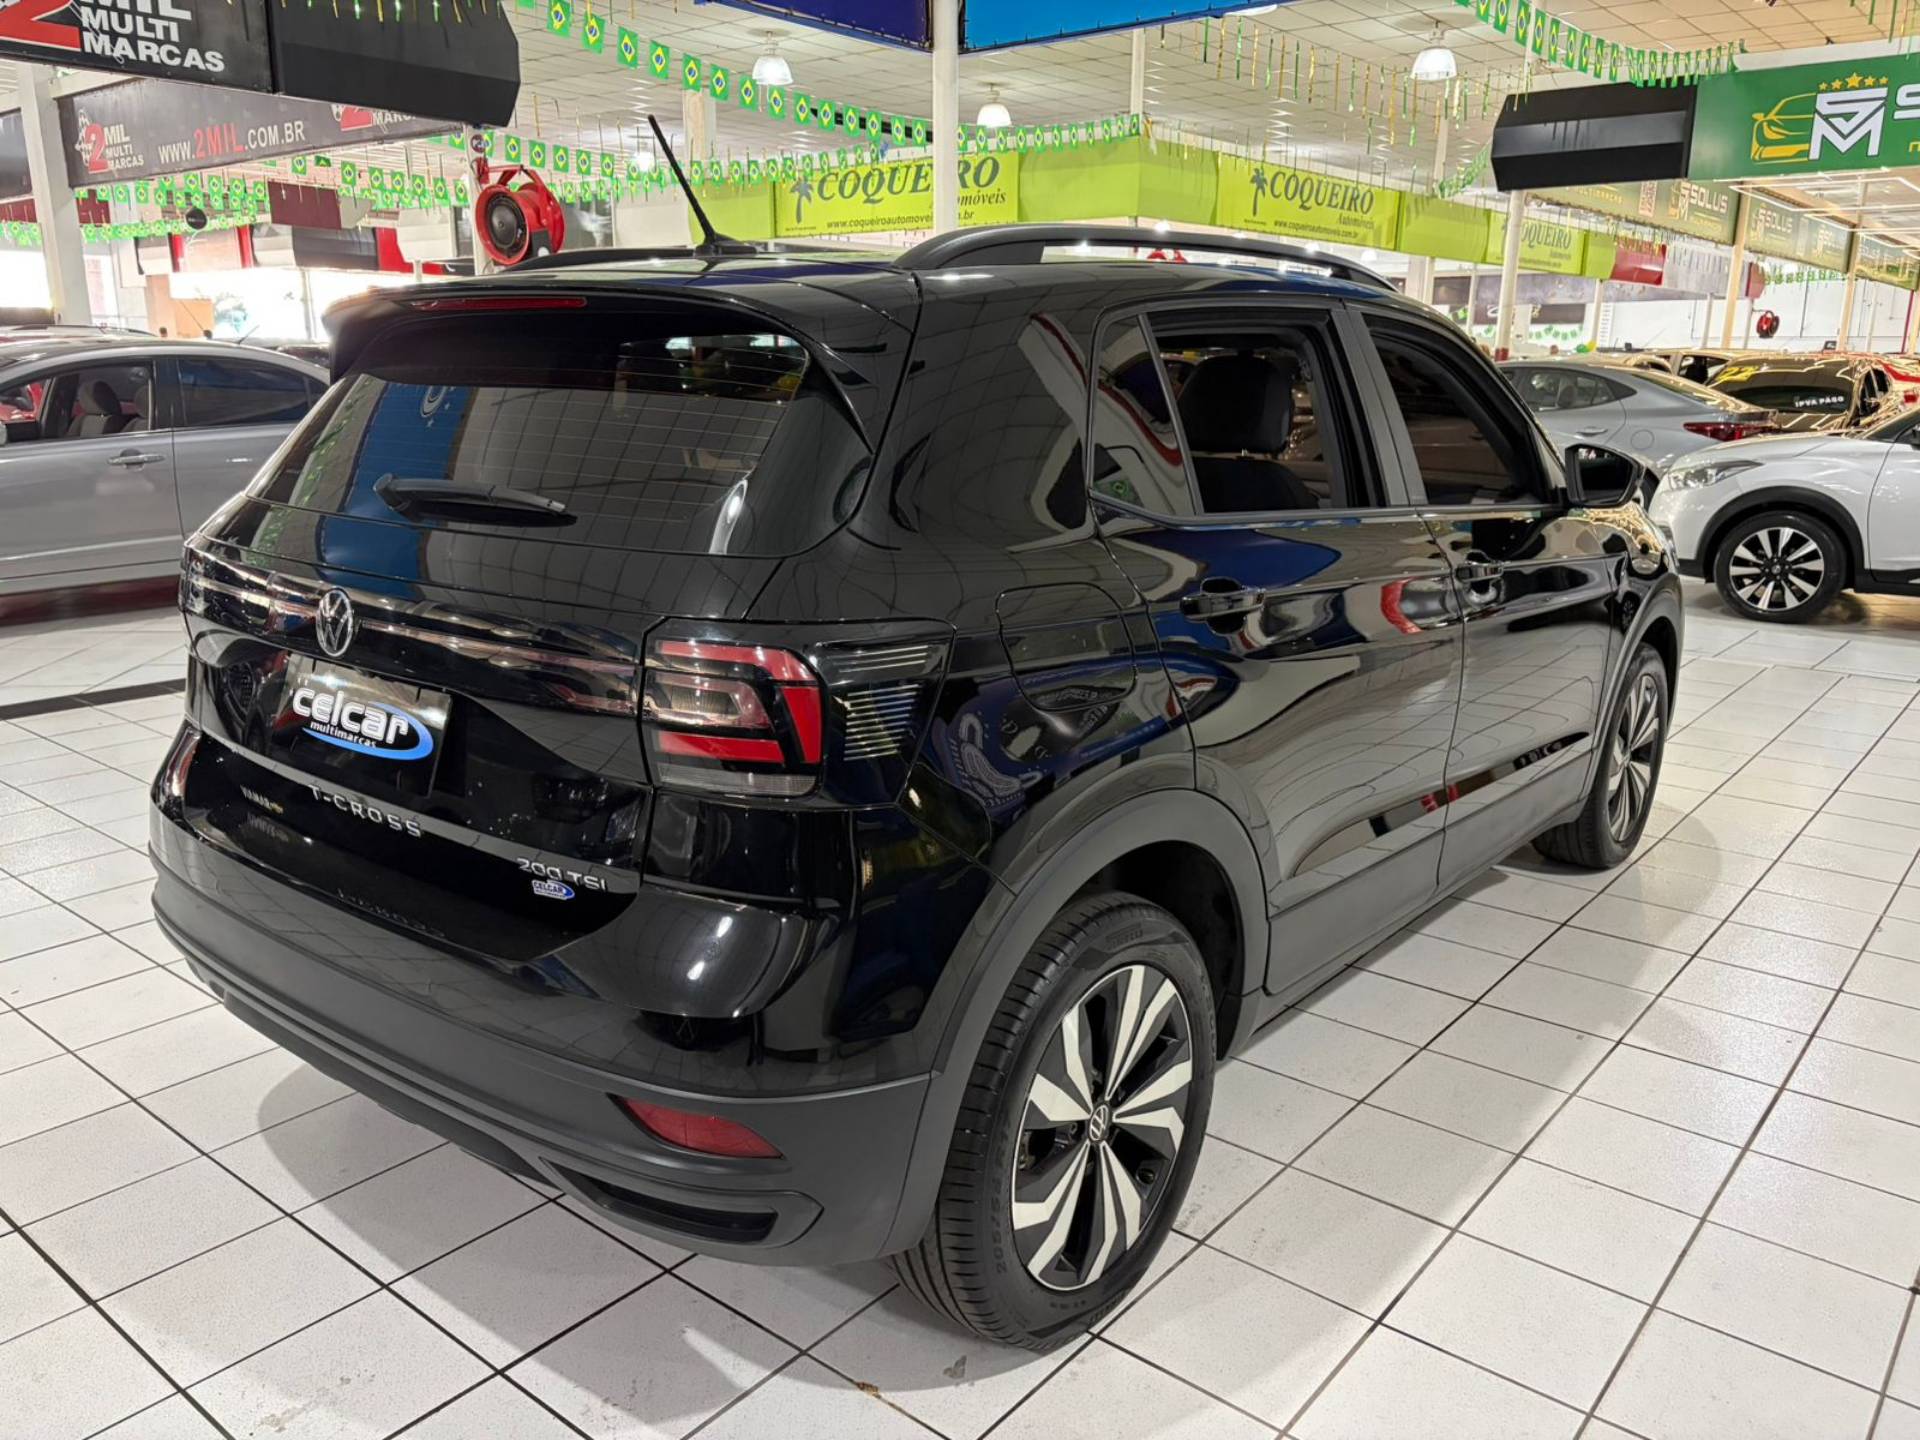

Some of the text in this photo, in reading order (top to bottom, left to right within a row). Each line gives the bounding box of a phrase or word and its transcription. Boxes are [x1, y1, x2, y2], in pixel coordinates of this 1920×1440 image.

[80, 6, 180, 42] MULTI
[82, 31, 225, 73] MARCAS
[85, 123, 130, 174] 2 MIL
[106, 143, 133, 159] MULTI
[107, 154, 144, 171] MARCAS
[817, 156, 1000, 205] COQUERO
[1270, 171, 1375, 215] COQUEIRO
[1690, 184, 1728, 214] SOLUS
[1521, 220, 1572, 250] OQUEIRO
[292, 687, 410, 745] celcar
[310, 720, 377, 748] multimarcas
[308, 784, 422, 839] T-CROSS
[517, 857, 607, 891] 200 TSI
